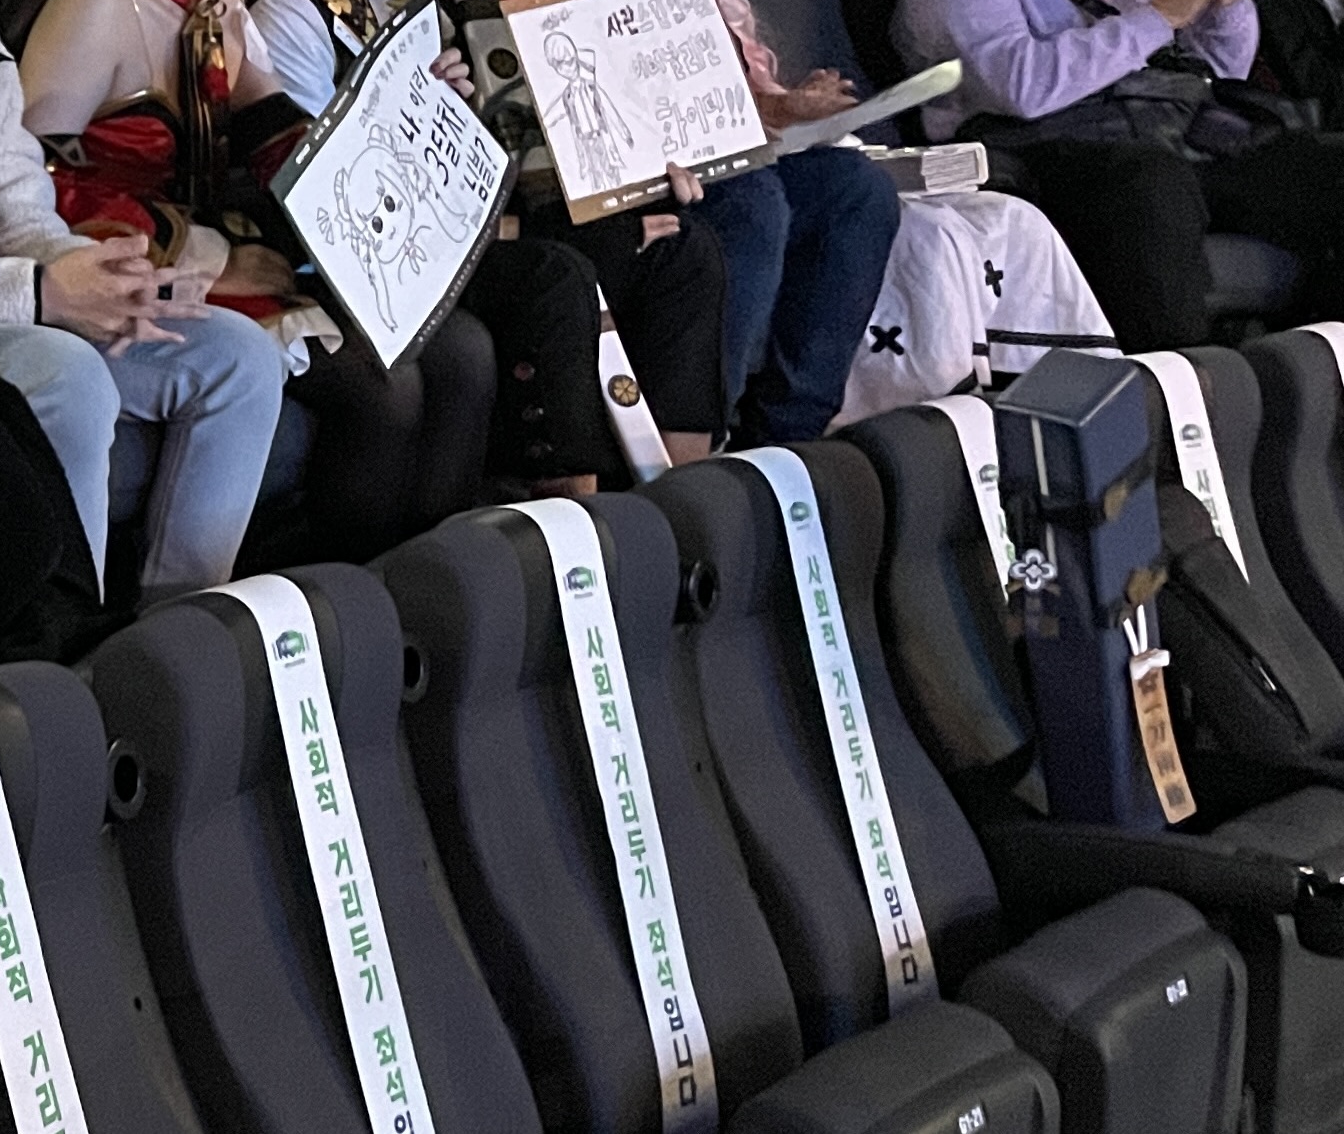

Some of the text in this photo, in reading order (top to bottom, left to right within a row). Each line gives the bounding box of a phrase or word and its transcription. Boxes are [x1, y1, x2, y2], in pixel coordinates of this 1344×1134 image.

[299, 697, 340, 816] 사회적
[328, 837, 384, 1004] 거리두기
[586, 625, 698, 1108] 사회적 거리두기 좌석입니다
[807, 554, 919, 986] 사회적 거리두기 좌석입니다
[23, 1029, 67, 1134] 거리
